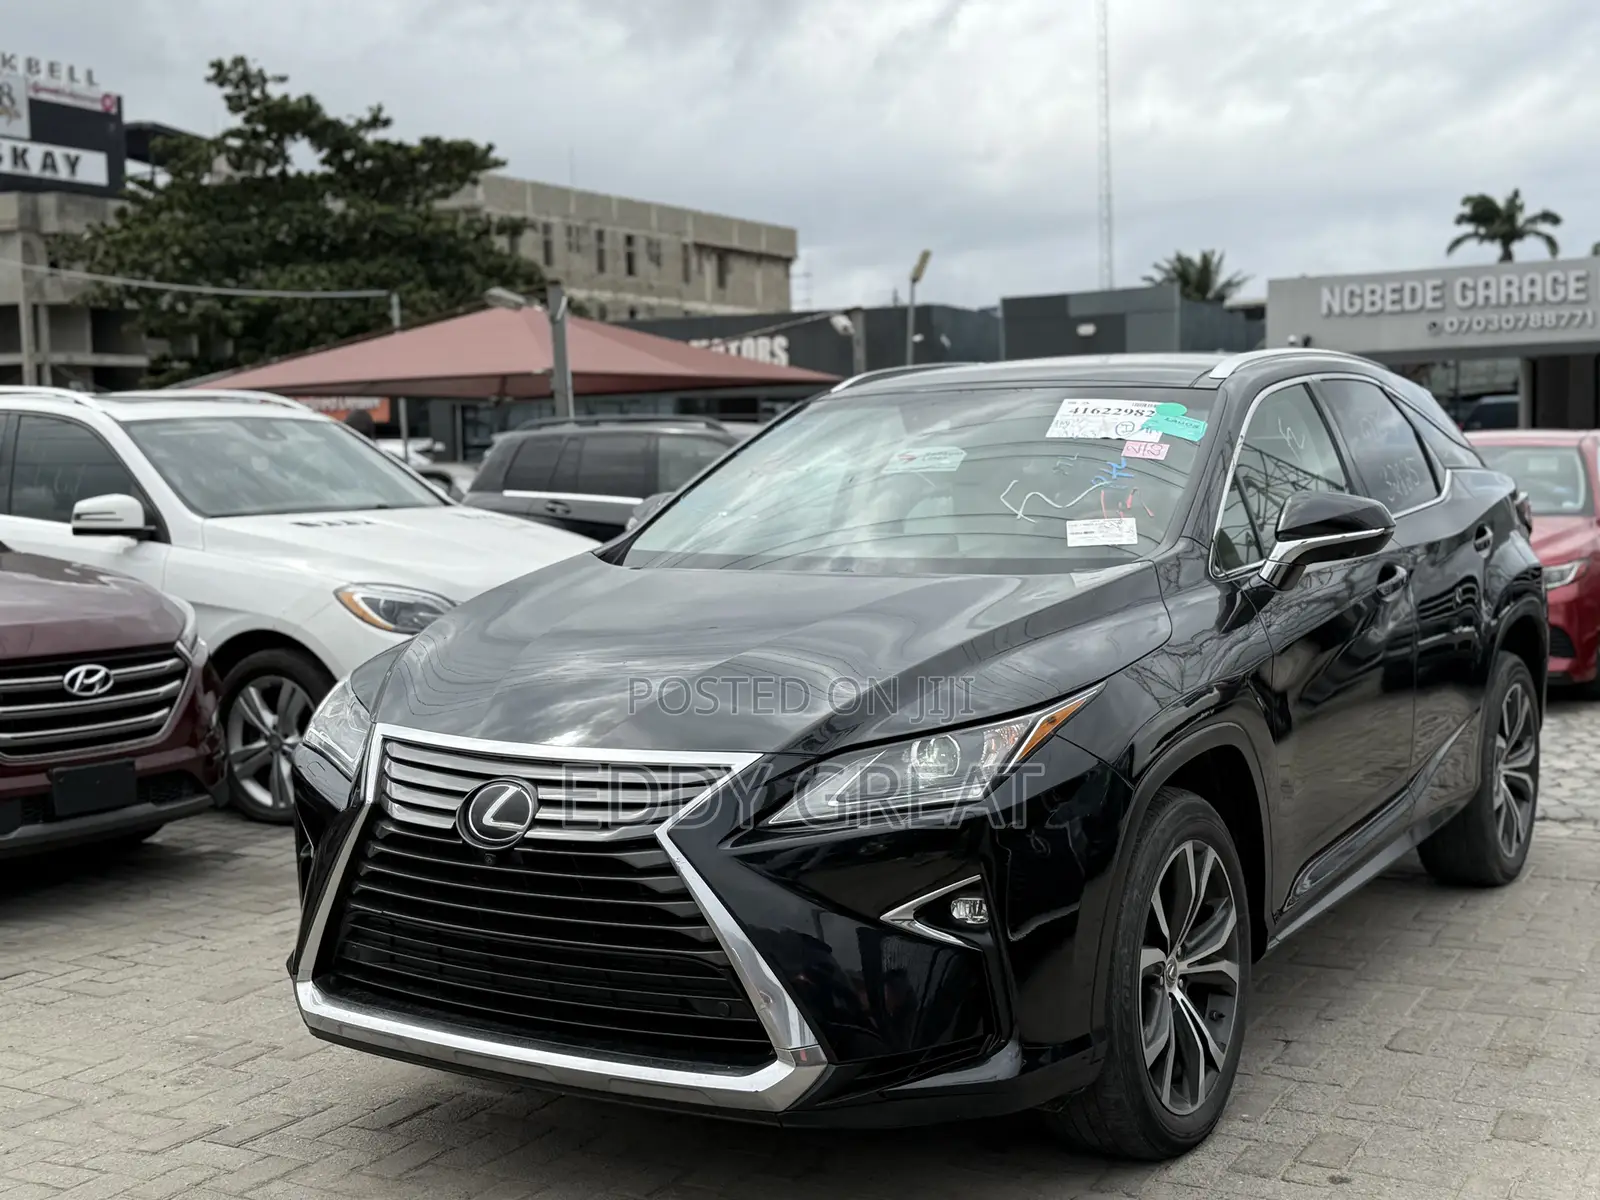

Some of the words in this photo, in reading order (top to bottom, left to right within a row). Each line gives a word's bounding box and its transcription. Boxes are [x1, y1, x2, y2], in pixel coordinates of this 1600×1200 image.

[0, 145, 82, 177] KAY
[1320, 279, 1444, 317] NGBEDE
[1454, 269, 1588, 308] GARAGE
[1068, 406, 1156, 418] 41622982
